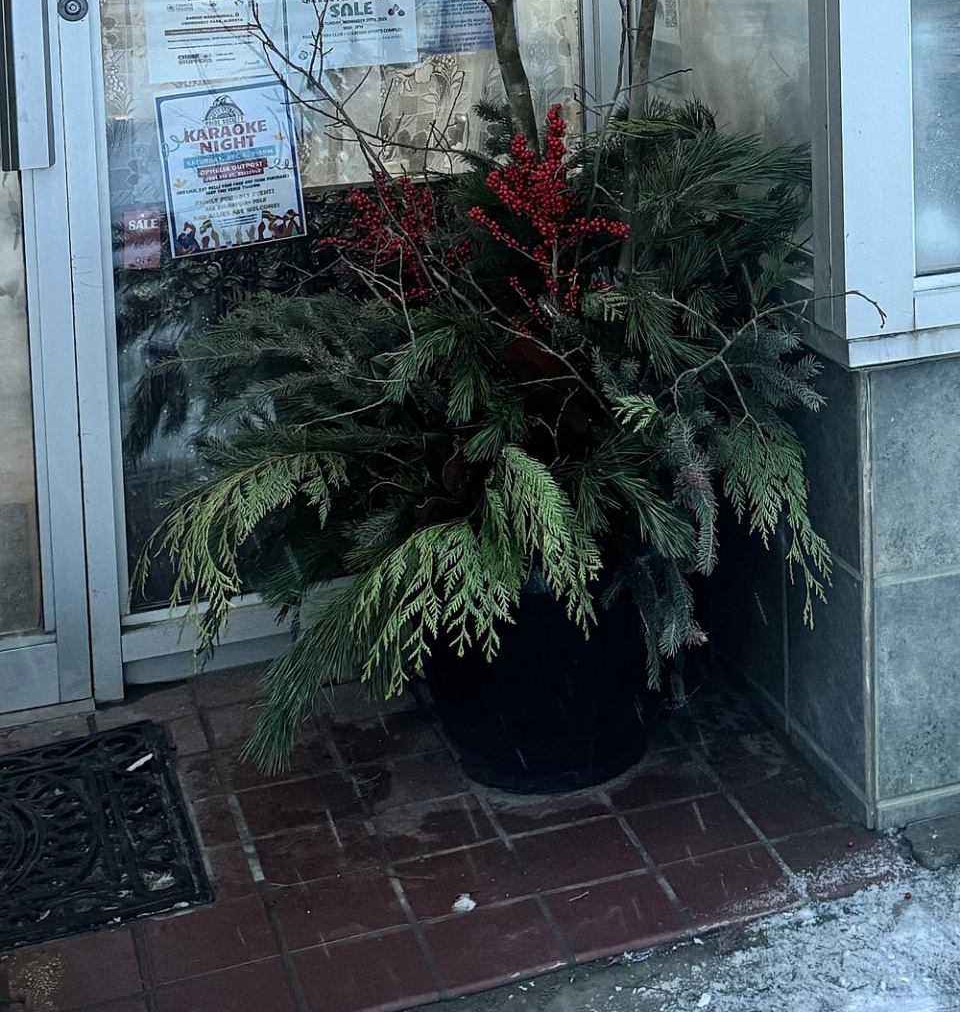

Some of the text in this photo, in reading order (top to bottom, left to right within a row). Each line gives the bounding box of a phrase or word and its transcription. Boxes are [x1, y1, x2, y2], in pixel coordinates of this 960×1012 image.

[329, 1, 374, 18] SALE
[183, 119, 268, 143] KARAOKE
[199, 134, 256, 155] NIGHT
[200, 161, 263, 176] OPHELIA OUTPOST
[128, 218, 159, 231] SALE
